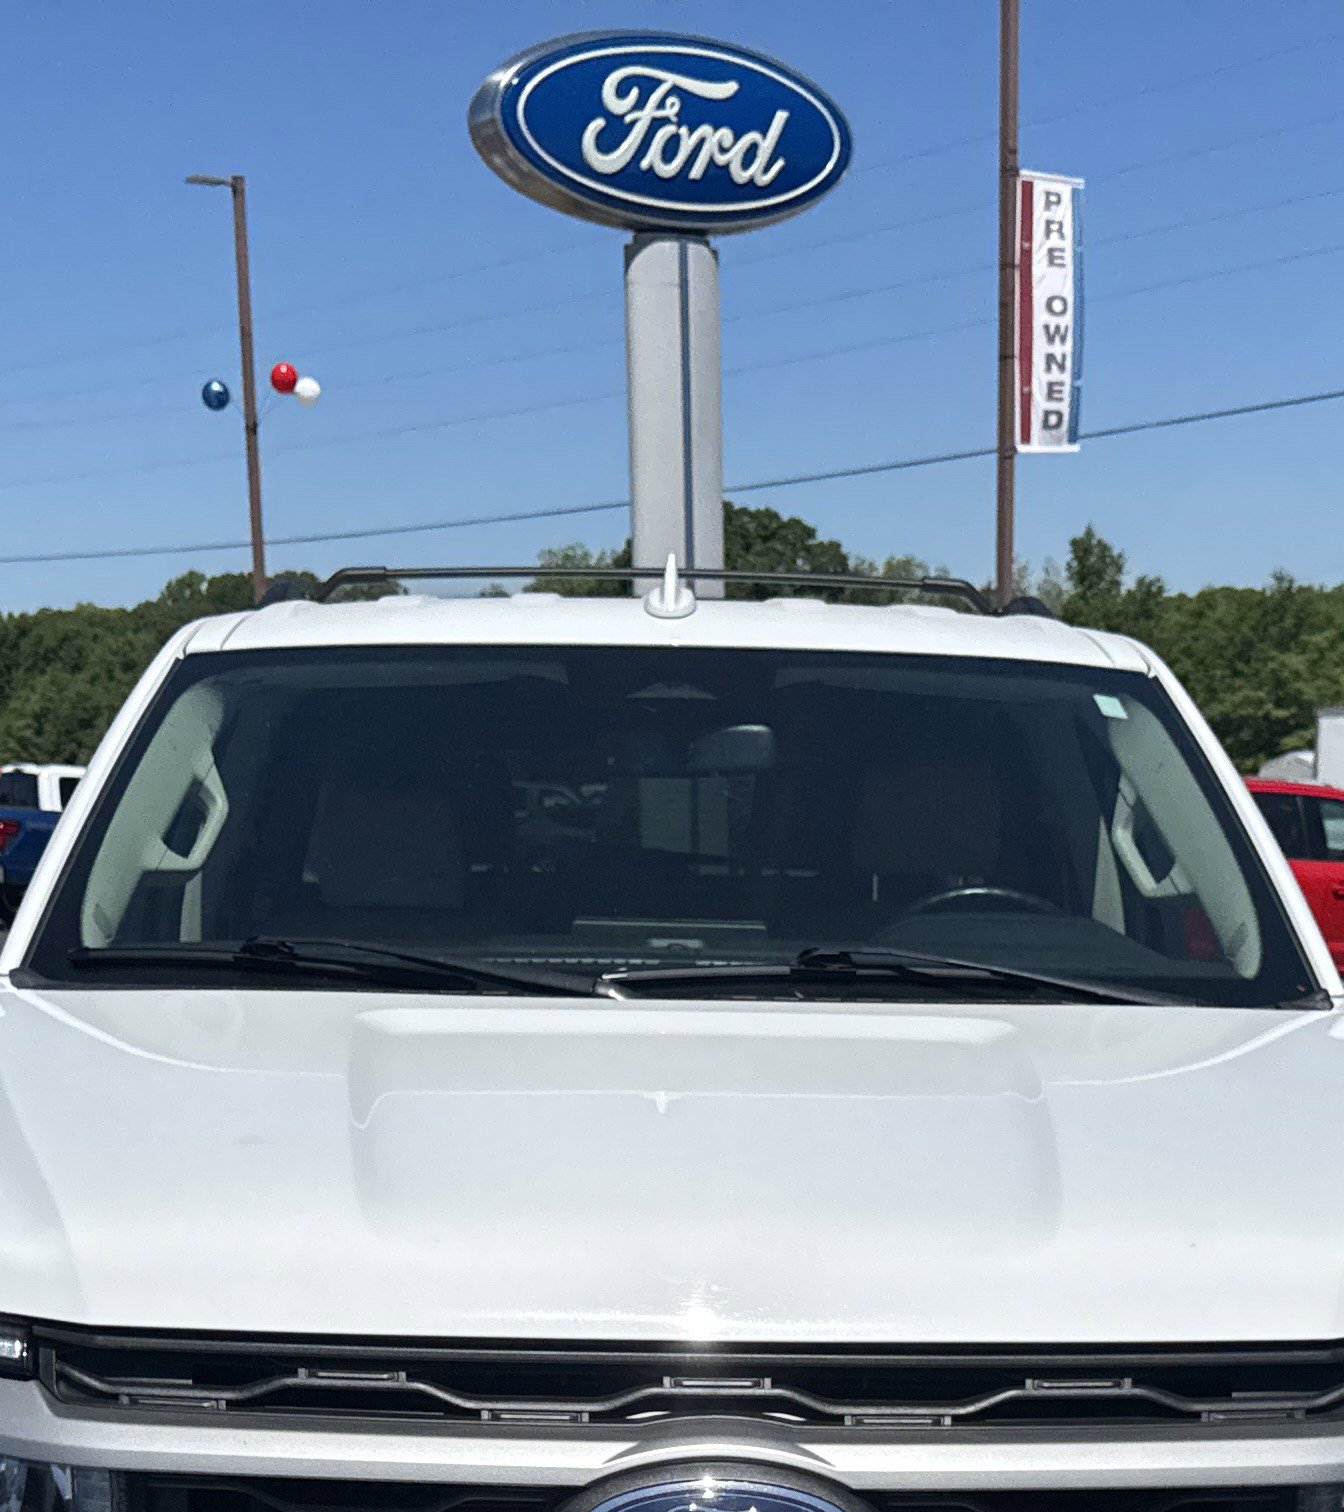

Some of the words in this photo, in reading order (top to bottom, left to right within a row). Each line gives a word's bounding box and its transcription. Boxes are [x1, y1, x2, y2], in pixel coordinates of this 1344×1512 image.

[581, 65, 787, 187] Ford
[1043, 191, 1066, 268] PRE
[1042, 295, 1069, 431] OWNED
